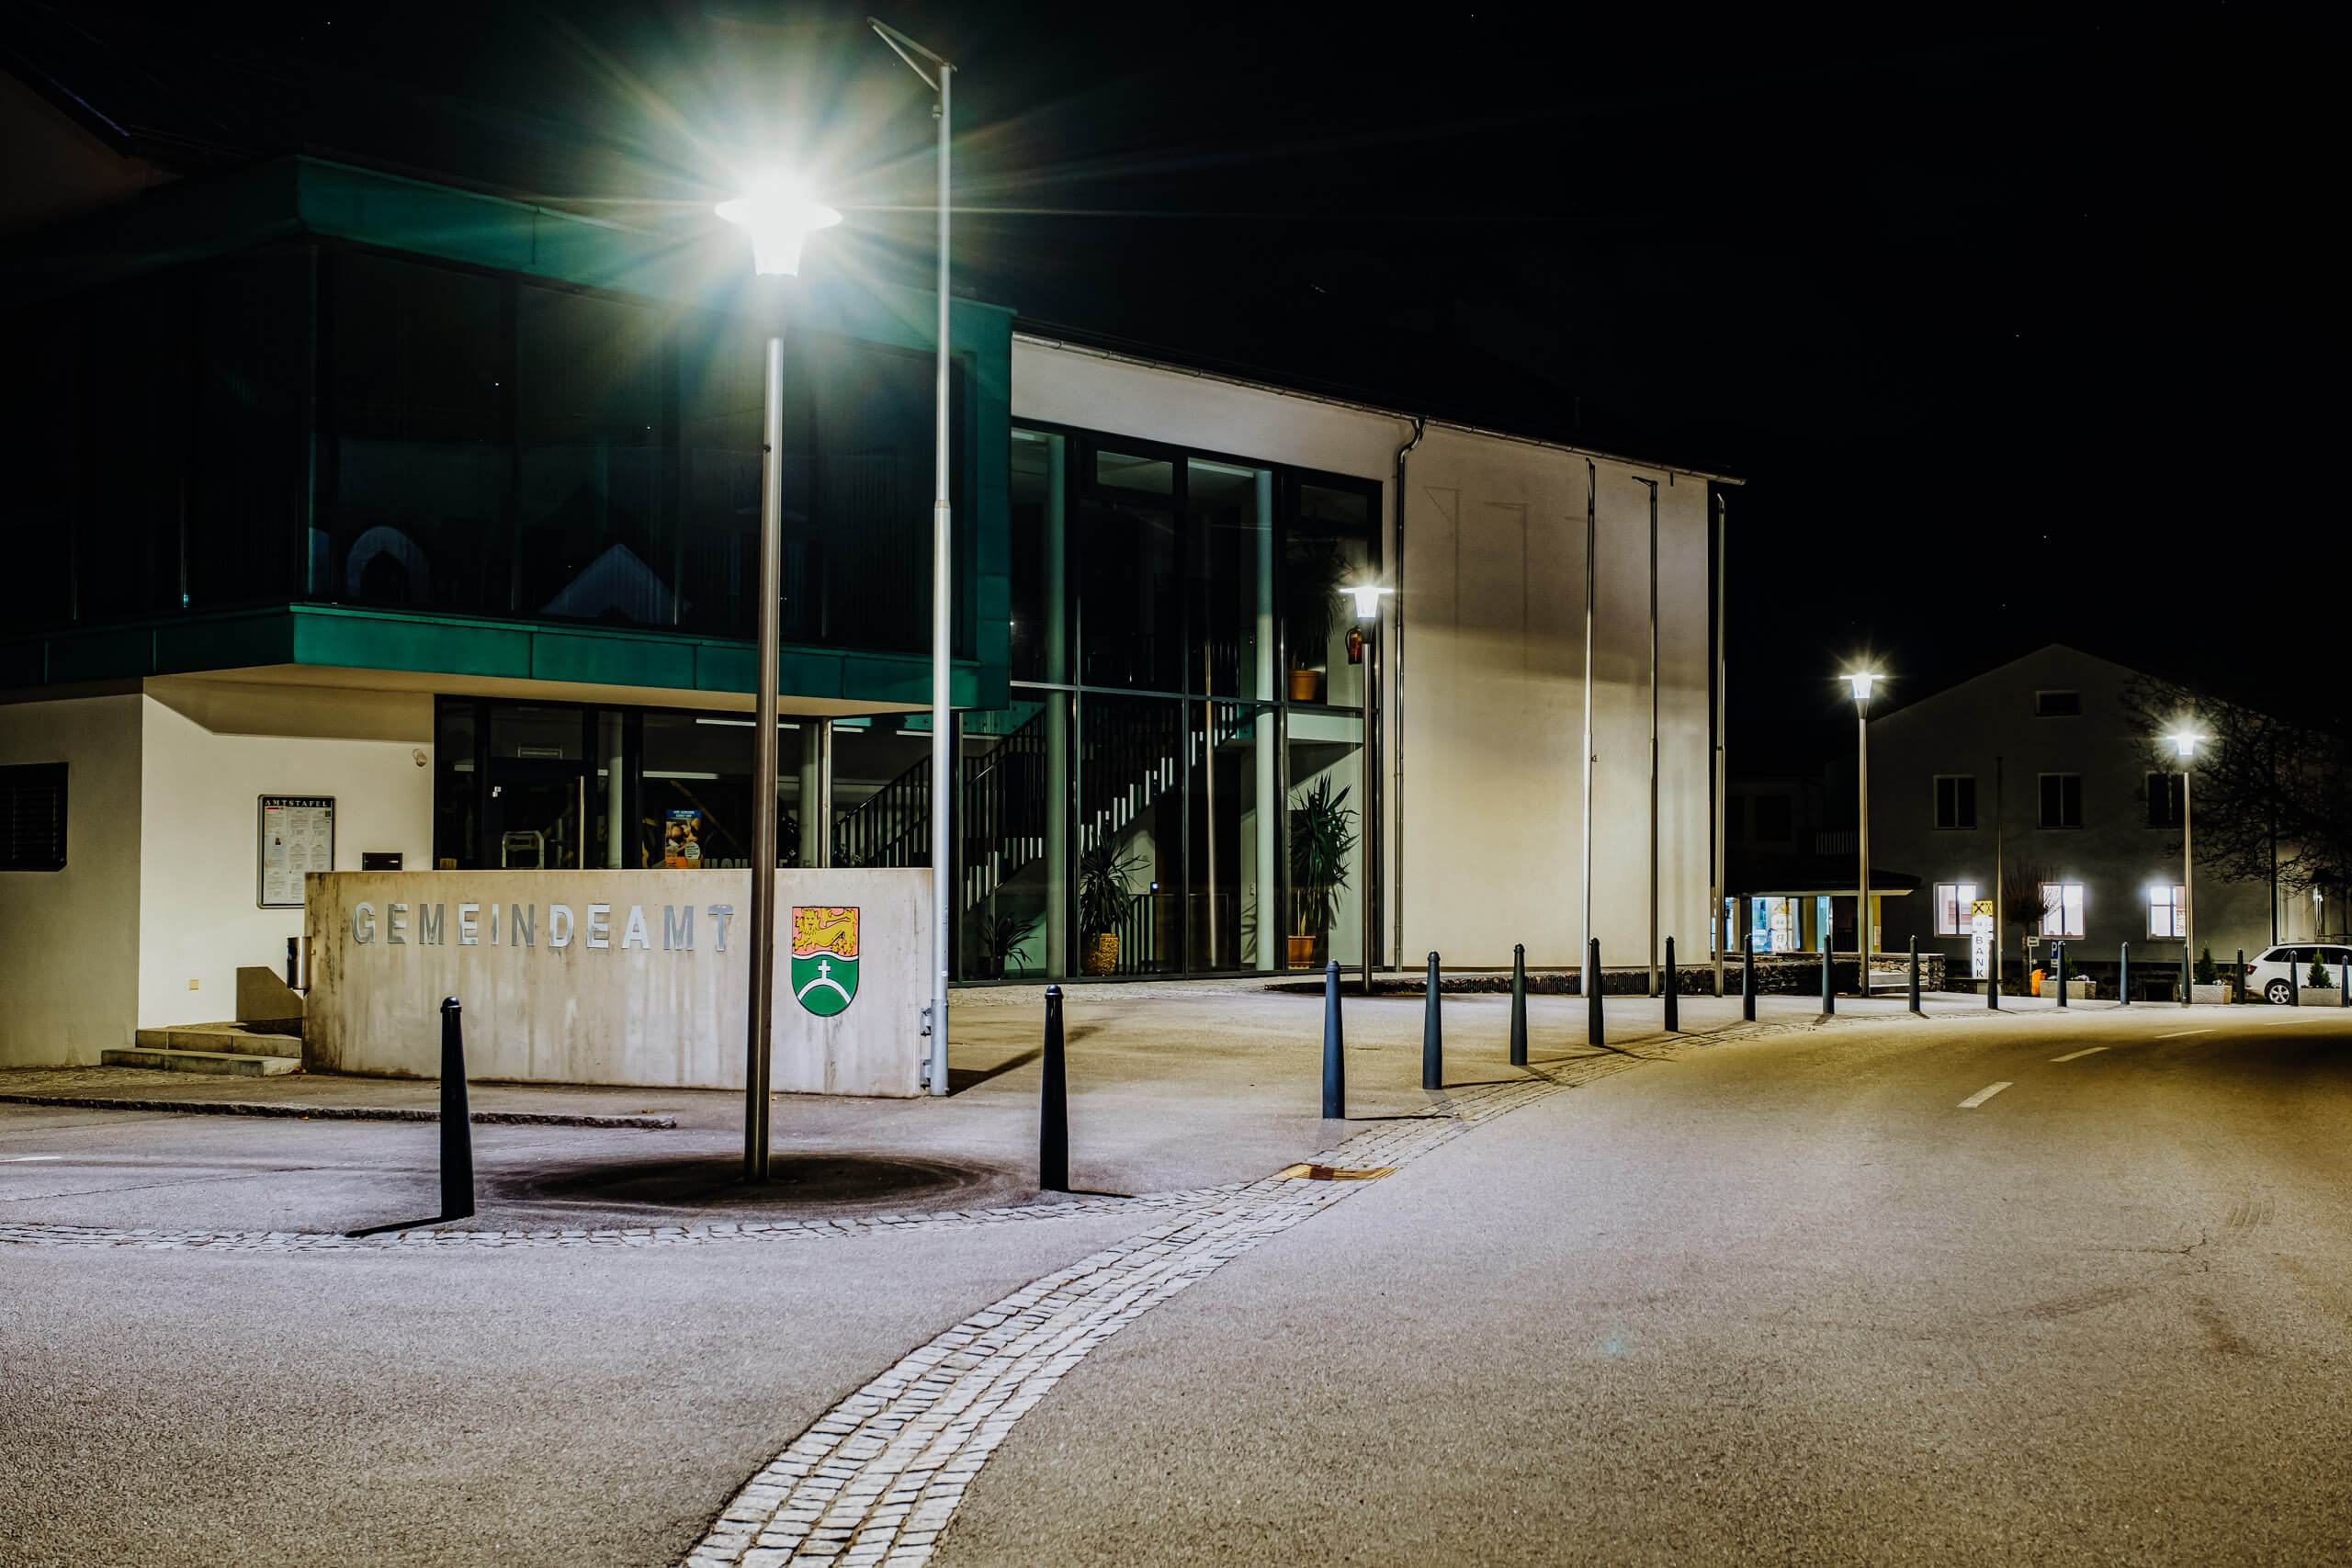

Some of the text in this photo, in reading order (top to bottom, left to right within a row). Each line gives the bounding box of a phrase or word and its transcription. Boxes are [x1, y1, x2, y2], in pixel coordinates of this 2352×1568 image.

[265, 799, 327, 807] AMTSTAFEL
[352, 902, 734, 952] GEMEINDEAMT
[1975, 936, 1984, 977] BANK
[2051, 942, 2058, 957] P
